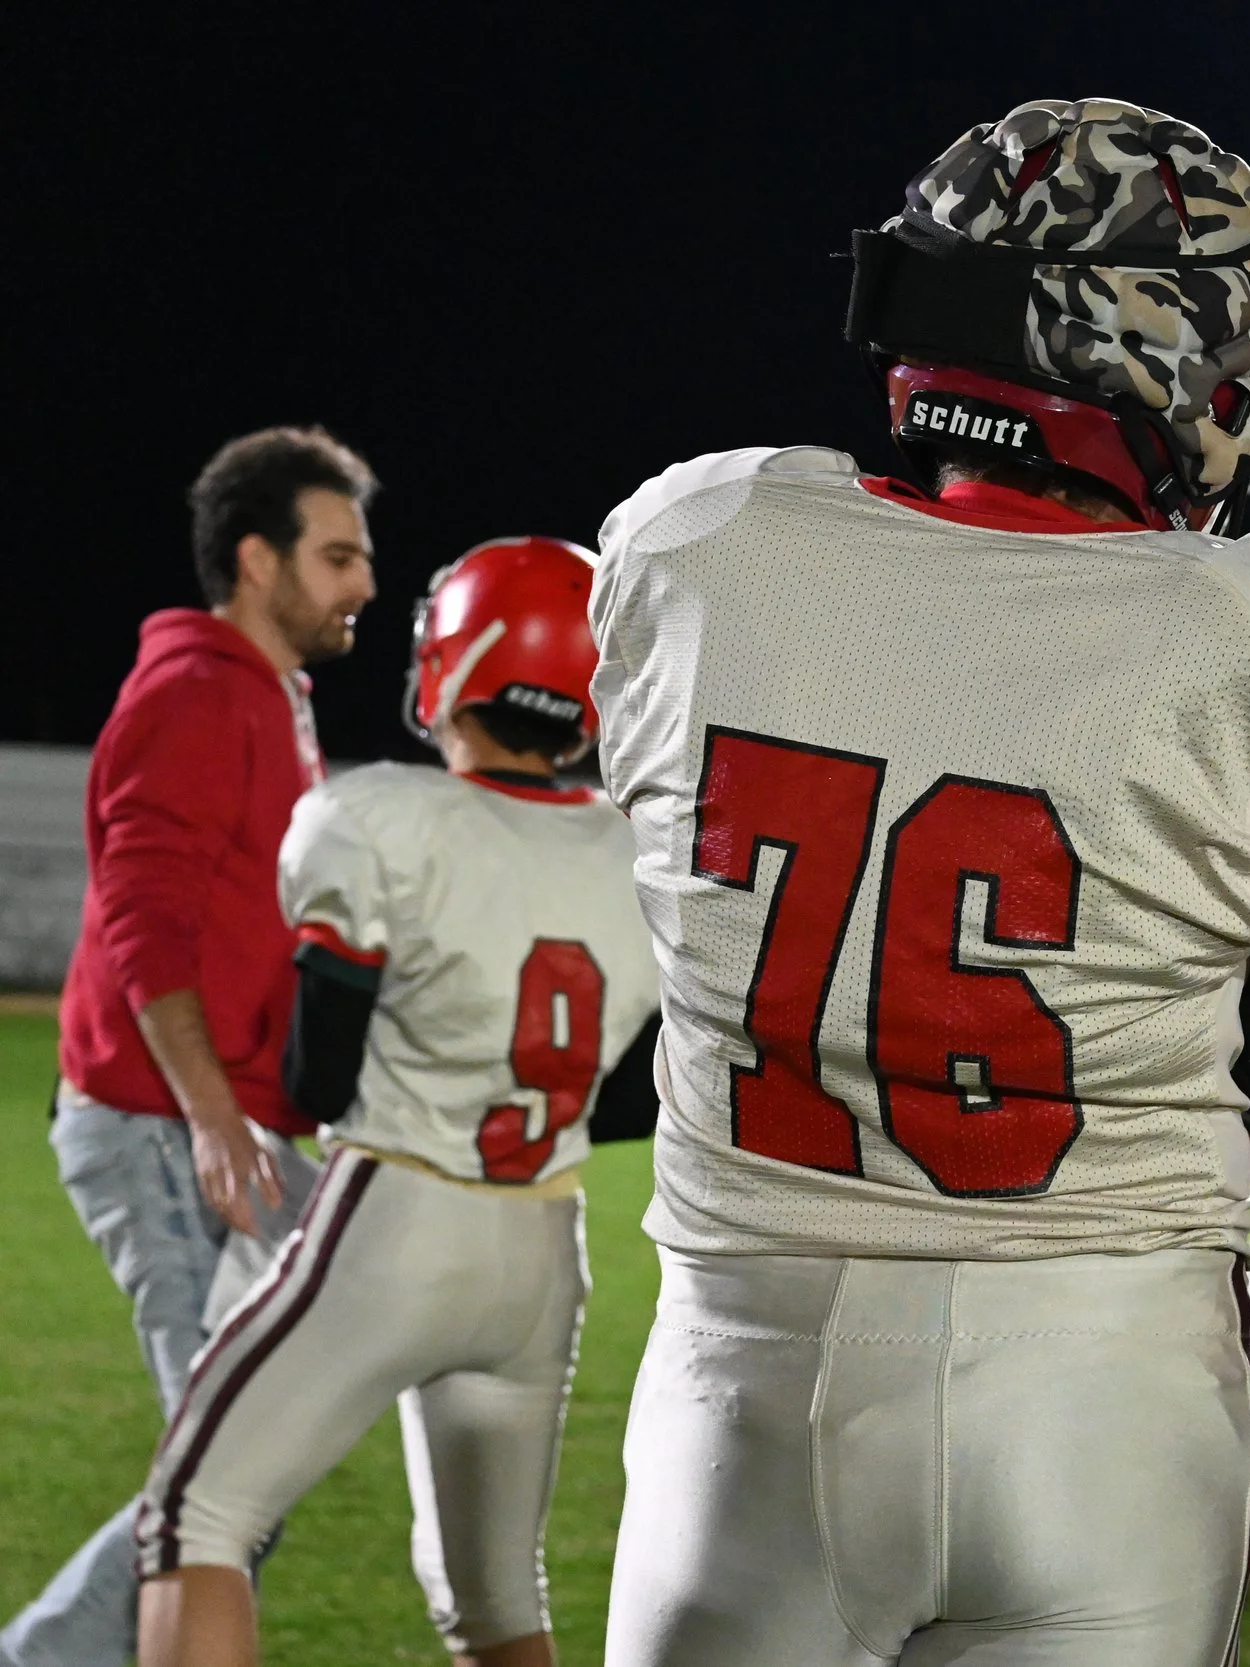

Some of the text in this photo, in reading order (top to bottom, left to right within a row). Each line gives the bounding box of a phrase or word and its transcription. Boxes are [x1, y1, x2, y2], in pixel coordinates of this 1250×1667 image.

[912, 401, 1029, 448] schutt
[1168, 508, 1188, 531] sch
[691, 724, 1085, 1199] 76
[475, 935, 607, 1186] 9
